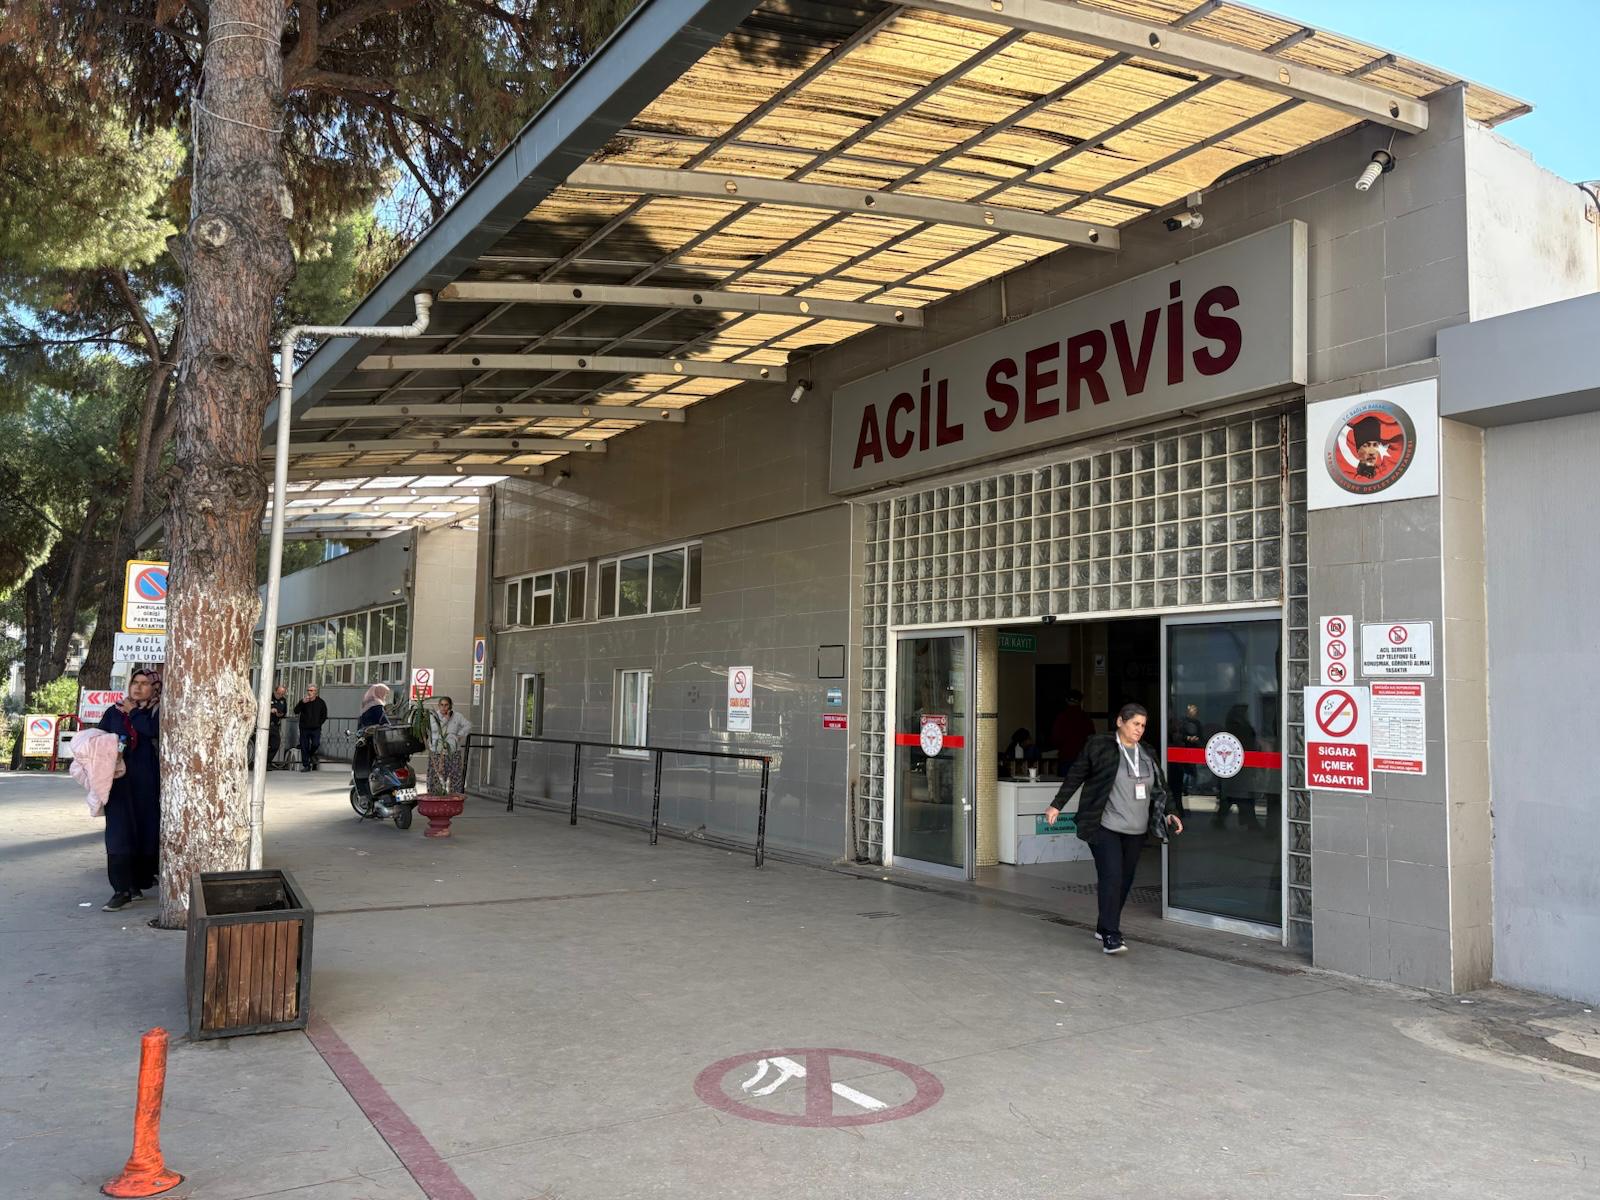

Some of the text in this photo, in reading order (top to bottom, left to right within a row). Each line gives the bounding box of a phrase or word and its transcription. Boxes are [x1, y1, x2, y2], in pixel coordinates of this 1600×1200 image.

[853, 279, 1242, 469] ACİL SERVİS
[1011, 636, 1033, 649] KAYIT
[1318, 745, 1357, 757] SİGARA
[1321, 759, 1354, 772] İÇMEK
[1312, 773, 1364, 786] YASAKTIR
